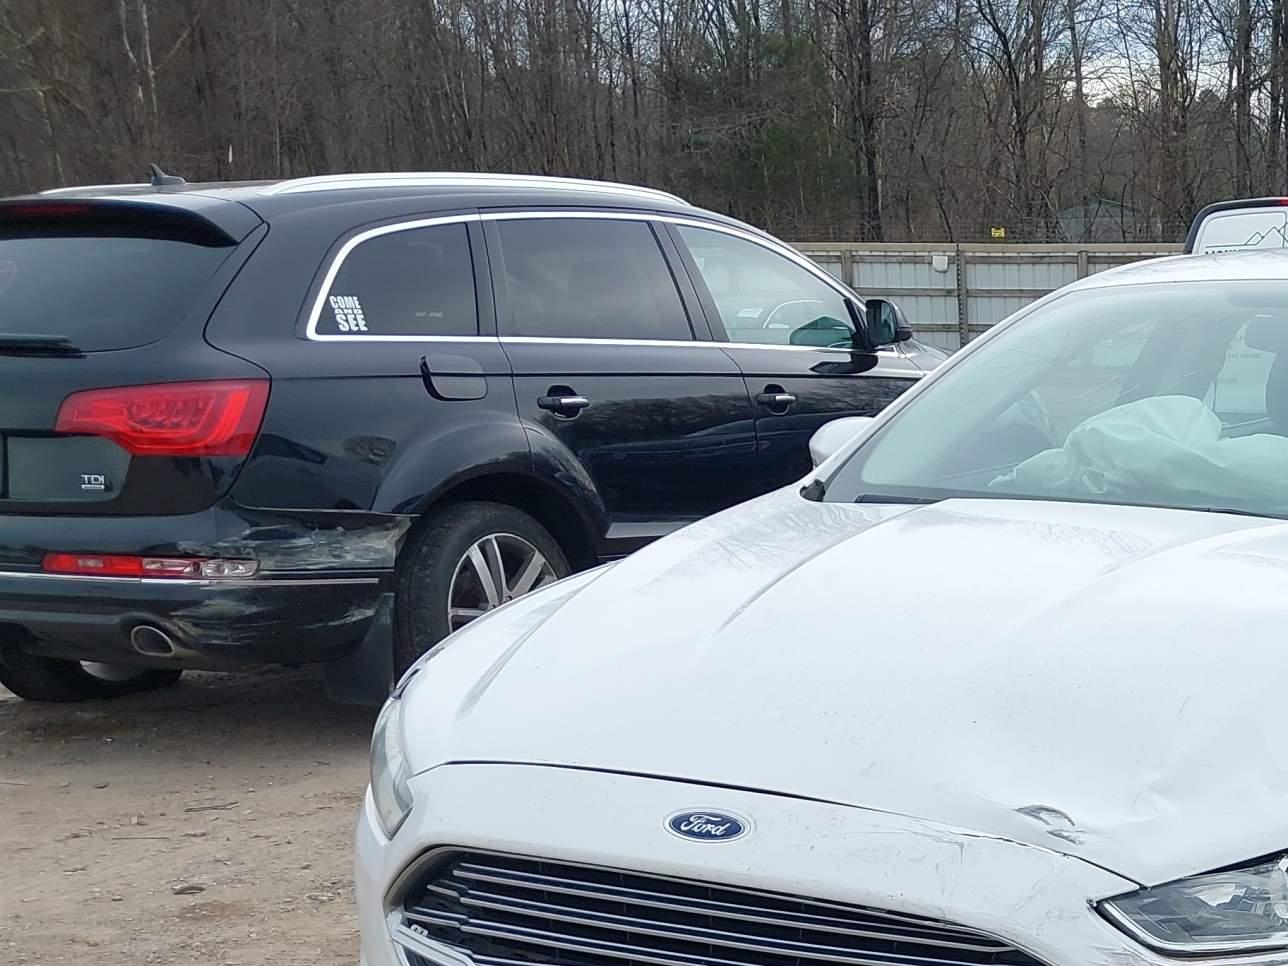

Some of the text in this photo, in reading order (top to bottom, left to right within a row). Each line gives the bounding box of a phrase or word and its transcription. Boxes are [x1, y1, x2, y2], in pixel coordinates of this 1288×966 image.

[329, 295, 361, 309] COME
[336, 314, 369, 331] SEE
[80, 474, 105, 484] TDI
[681, 814, 731, 836] Ford
